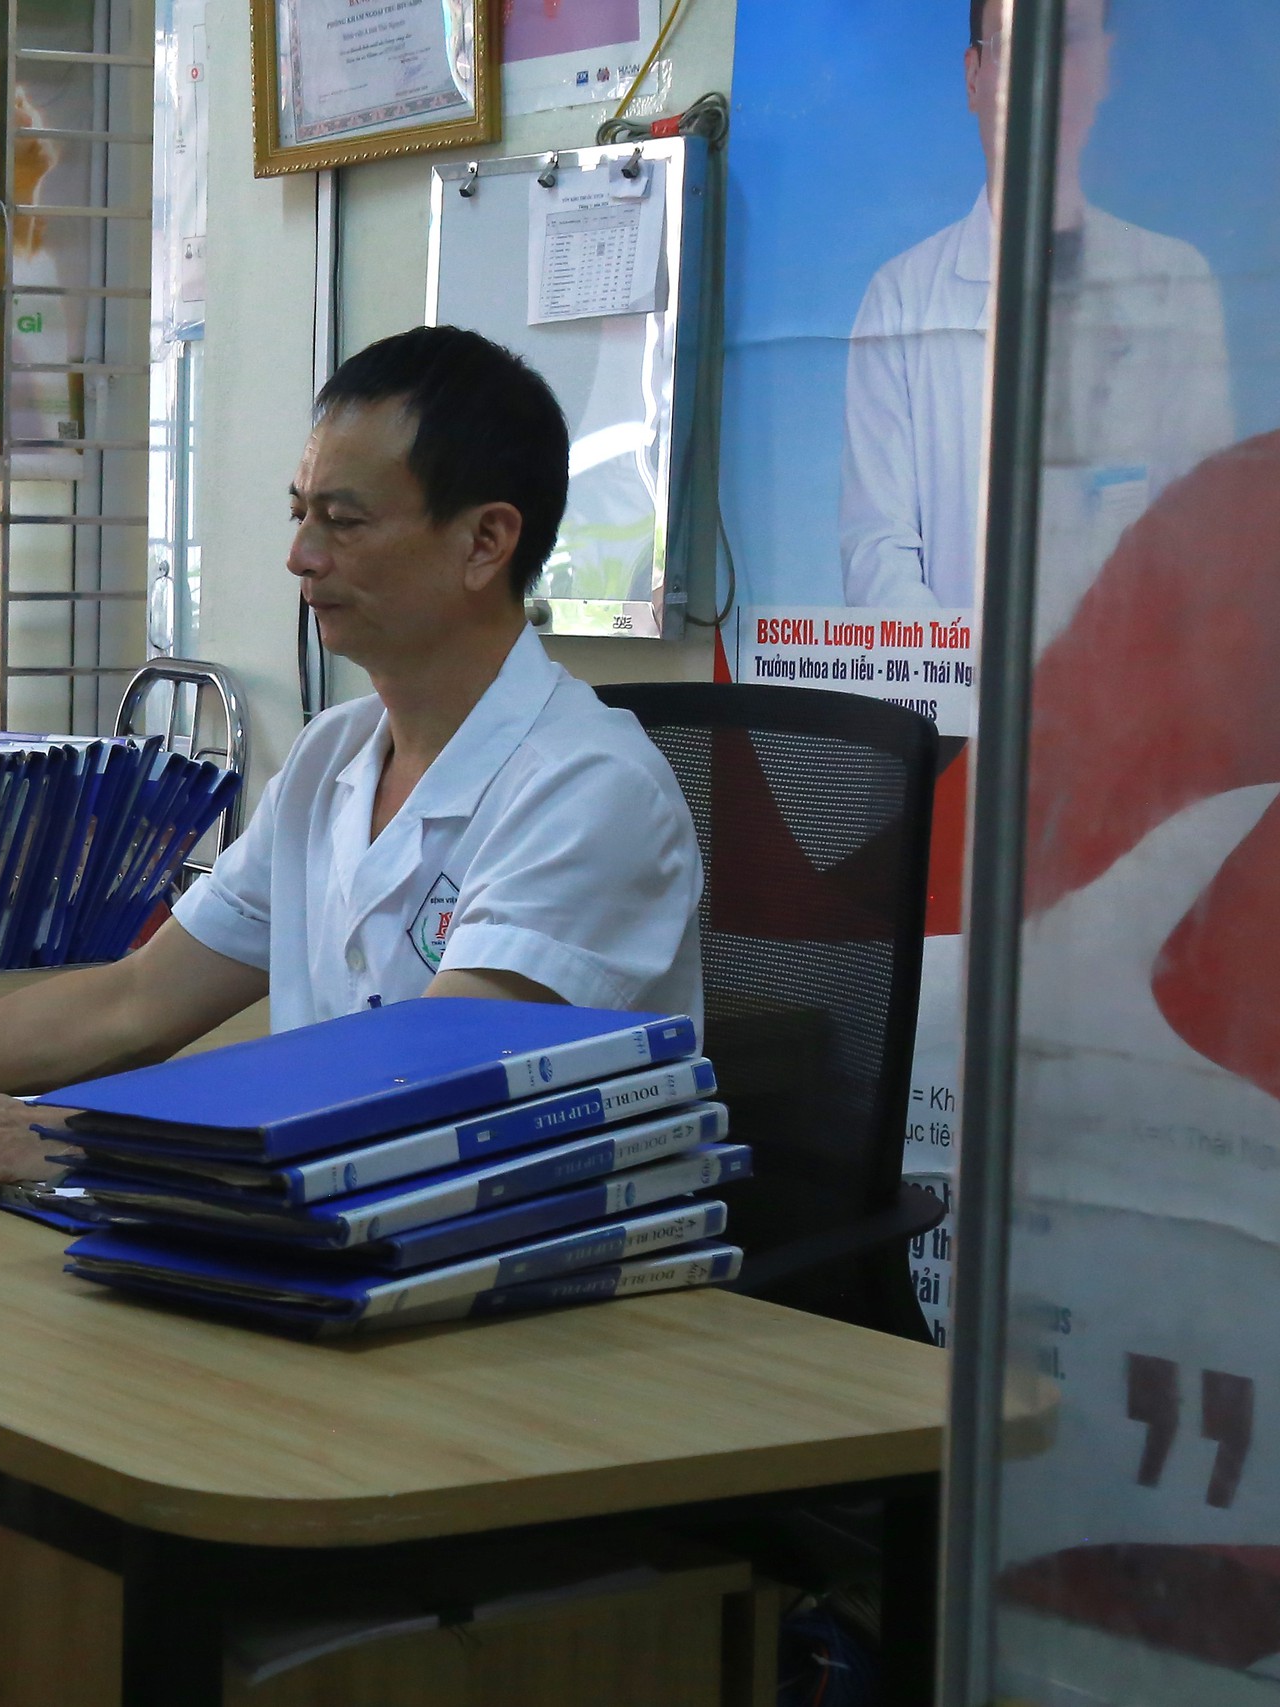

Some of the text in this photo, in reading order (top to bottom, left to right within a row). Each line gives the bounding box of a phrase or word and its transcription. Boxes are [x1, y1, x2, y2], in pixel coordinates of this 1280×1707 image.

[758, 617, 970, 650] BSCKII. Lương Minh Tuấn
[755, 653, 796, 681] Trưởng
[800, 657, 828, 680] khoa
[832, 658, 847, 680] da
[851, 654, 874, 680] liễu
[887, 660, 910, 682] BVA
[923, 660, 950, 684] Thái
[606, 1085, 659, 1110] DOUBLE
[536, 1111, 565, 1130] FILE
[568, 1102, 600, 1120] CLIP
[619, 1134, 667, 1158] DOUBLE
[583, 1150, 613, 1168] CLIP
[622, 1270, 675, 1287] DOUBLE
